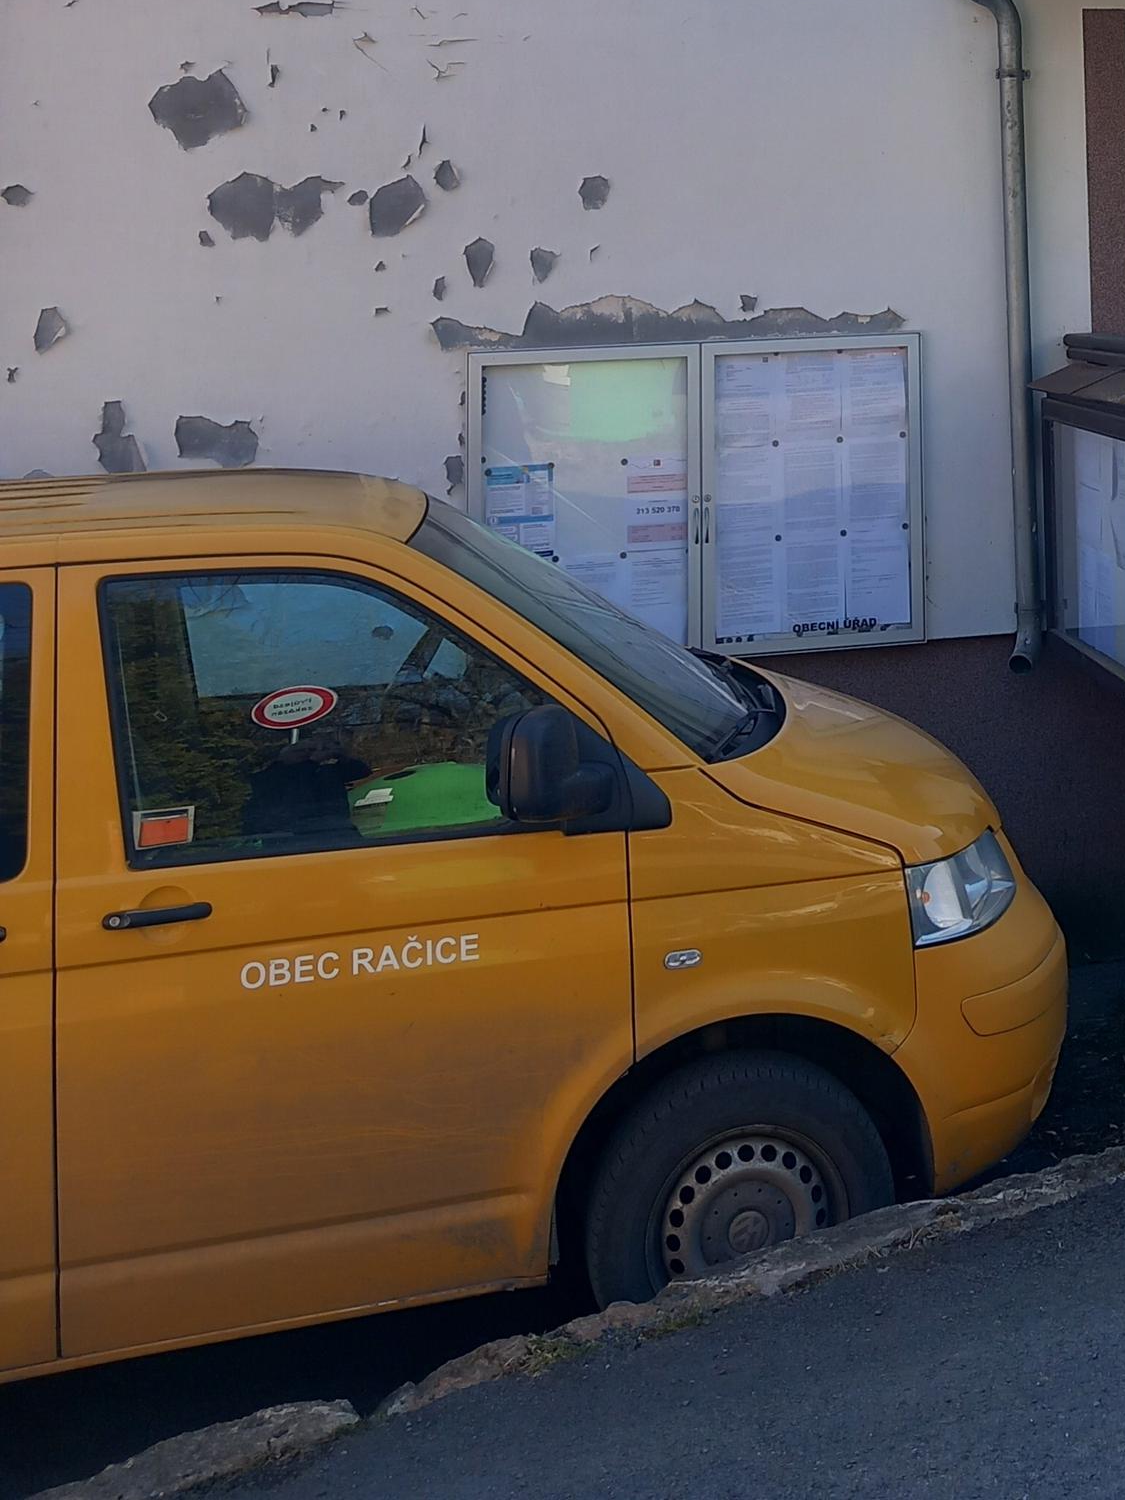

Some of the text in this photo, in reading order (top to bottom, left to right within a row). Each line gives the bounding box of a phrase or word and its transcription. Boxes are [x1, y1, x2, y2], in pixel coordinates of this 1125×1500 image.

[792, 616, 877, 634] OBECNÍ ÚŘAD
[240, 934, 481, 990] OBEC RAČICE
